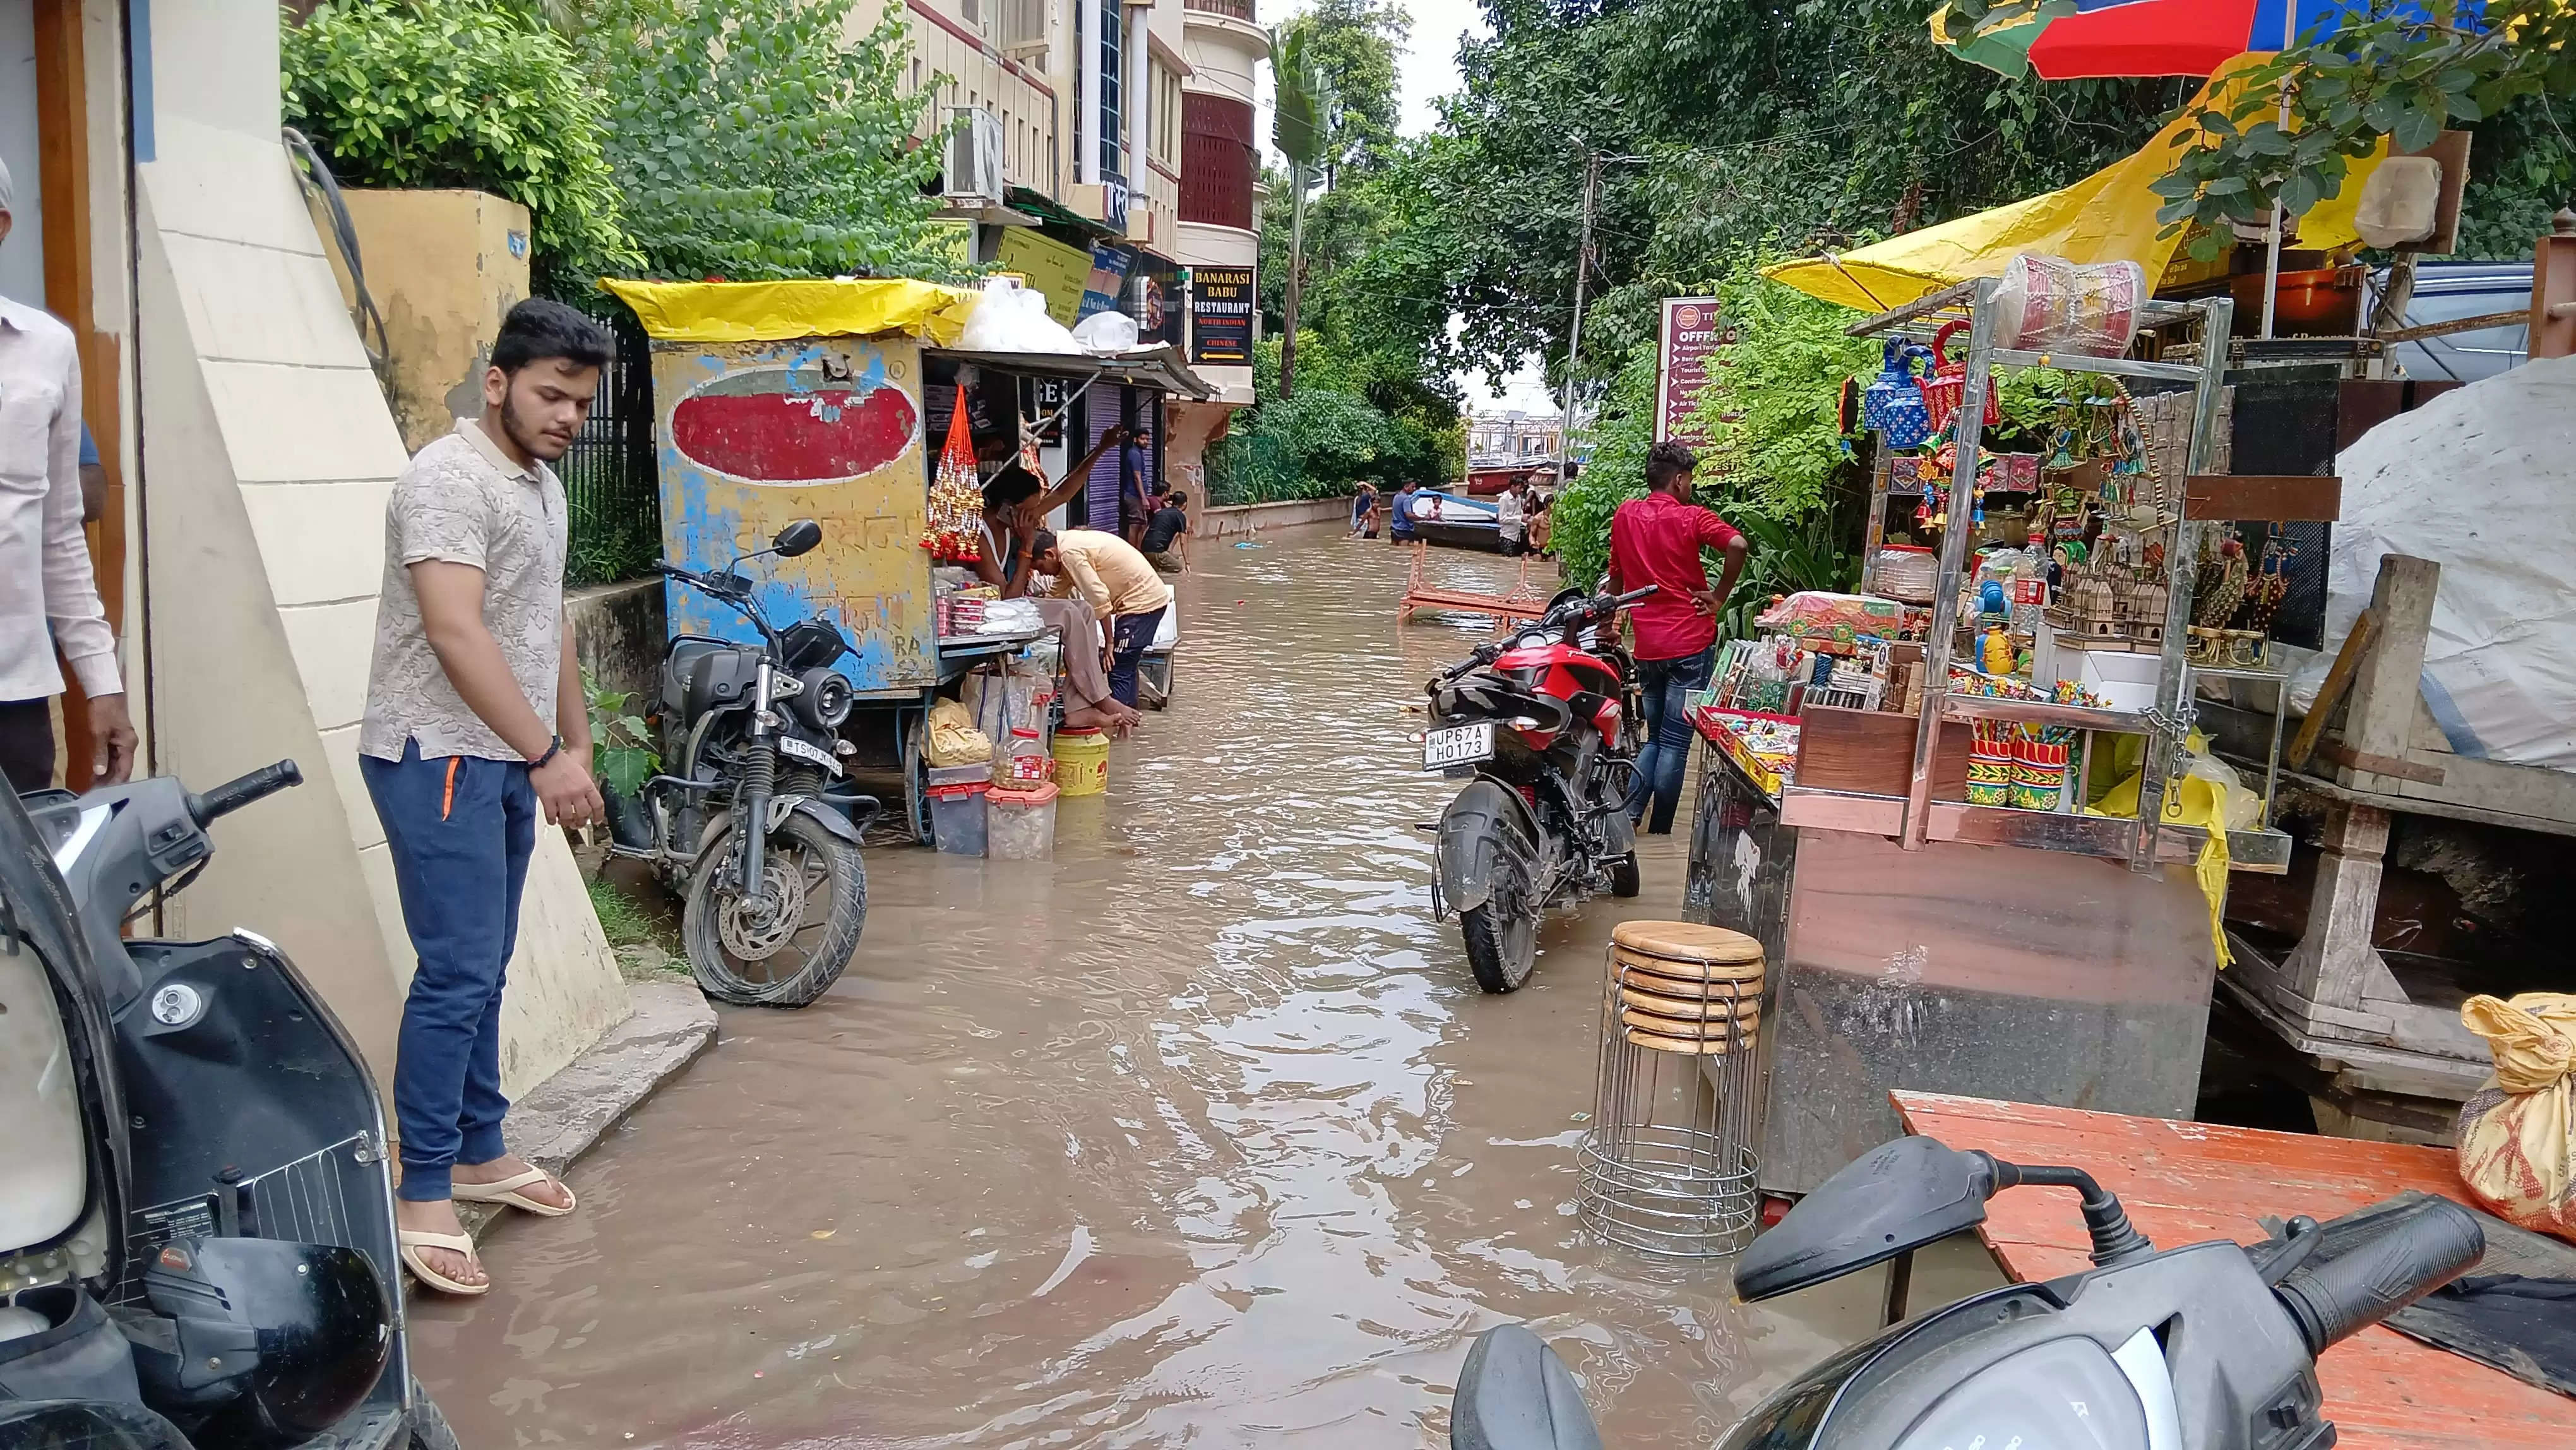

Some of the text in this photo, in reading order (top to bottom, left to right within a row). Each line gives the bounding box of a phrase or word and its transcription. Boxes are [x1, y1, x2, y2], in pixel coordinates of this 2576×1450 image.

[1195, 272, 1249, 284] BANARASI
[1207, 286, 1237, 297] BABU
[1195, 301, 1250, 314] RESTAURANT
[1681, 344, 1702, 352] Airport
[1437, 726, 1482, 745] UP67A
[1436, 741, 1482, 761] H0173
